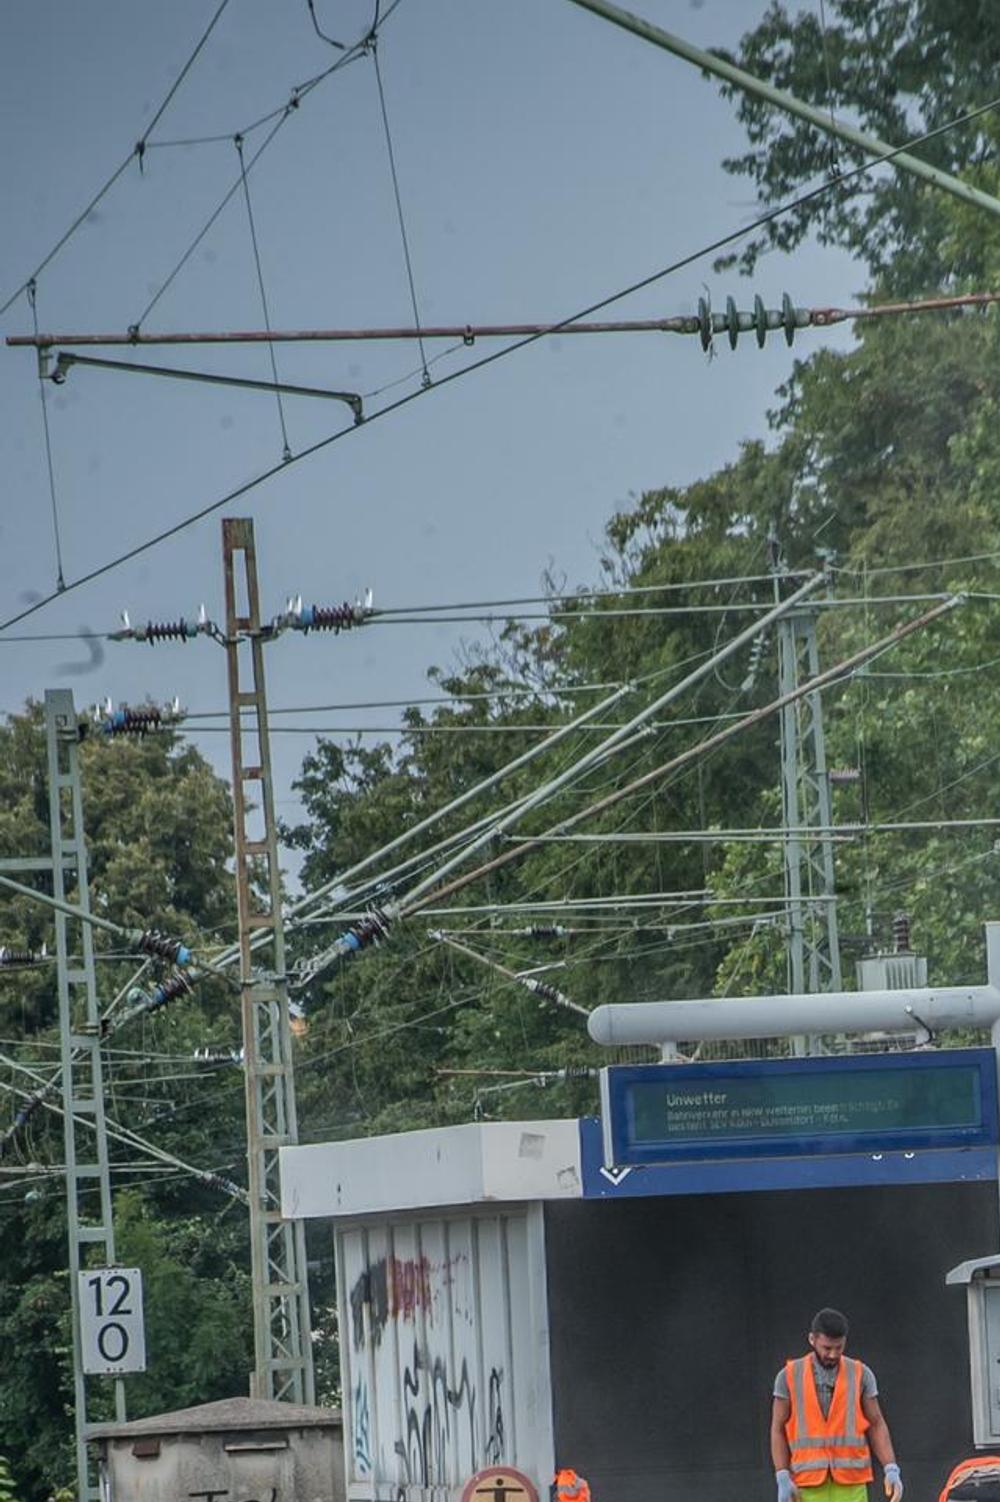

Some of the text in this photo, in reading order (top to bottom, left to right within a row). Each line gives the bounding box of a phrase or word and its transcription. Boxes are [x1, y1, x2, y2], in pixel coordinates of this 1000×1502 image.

[666, 1092, 728, 1106] Unwetter
[88, 1275, 133, 1317] 12
[97, 1322, 129, 1363] 0
